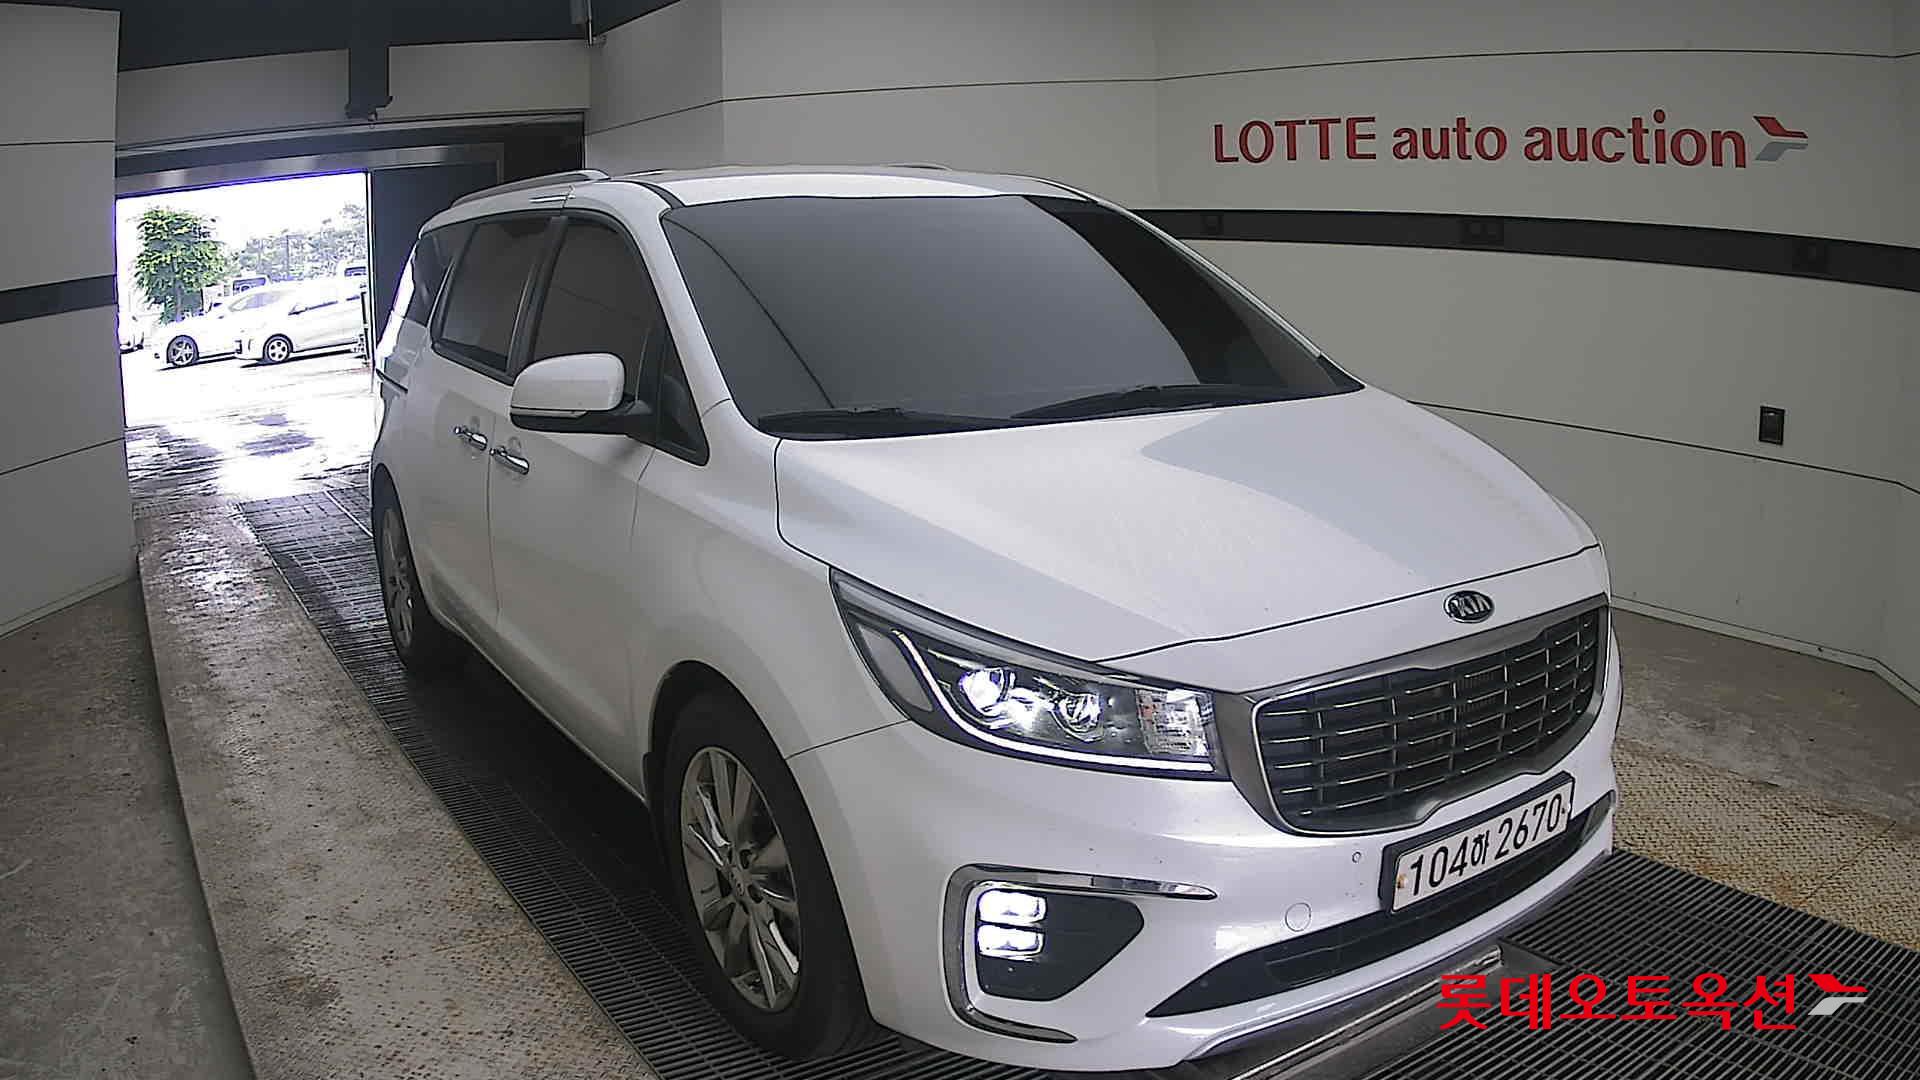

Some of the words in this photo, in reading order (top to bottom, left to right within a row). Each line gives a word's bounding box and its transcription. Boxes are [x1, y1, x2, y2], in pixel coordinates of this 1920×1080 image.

[1213, 116, 1377, 164] LOTTE
[1391, 116, 1508, 162] auto
[1523, 109, 1747, 168] auction
[1410, 829, 1491, 896] 104하
[1494, 793, 1562, 861] 2670
